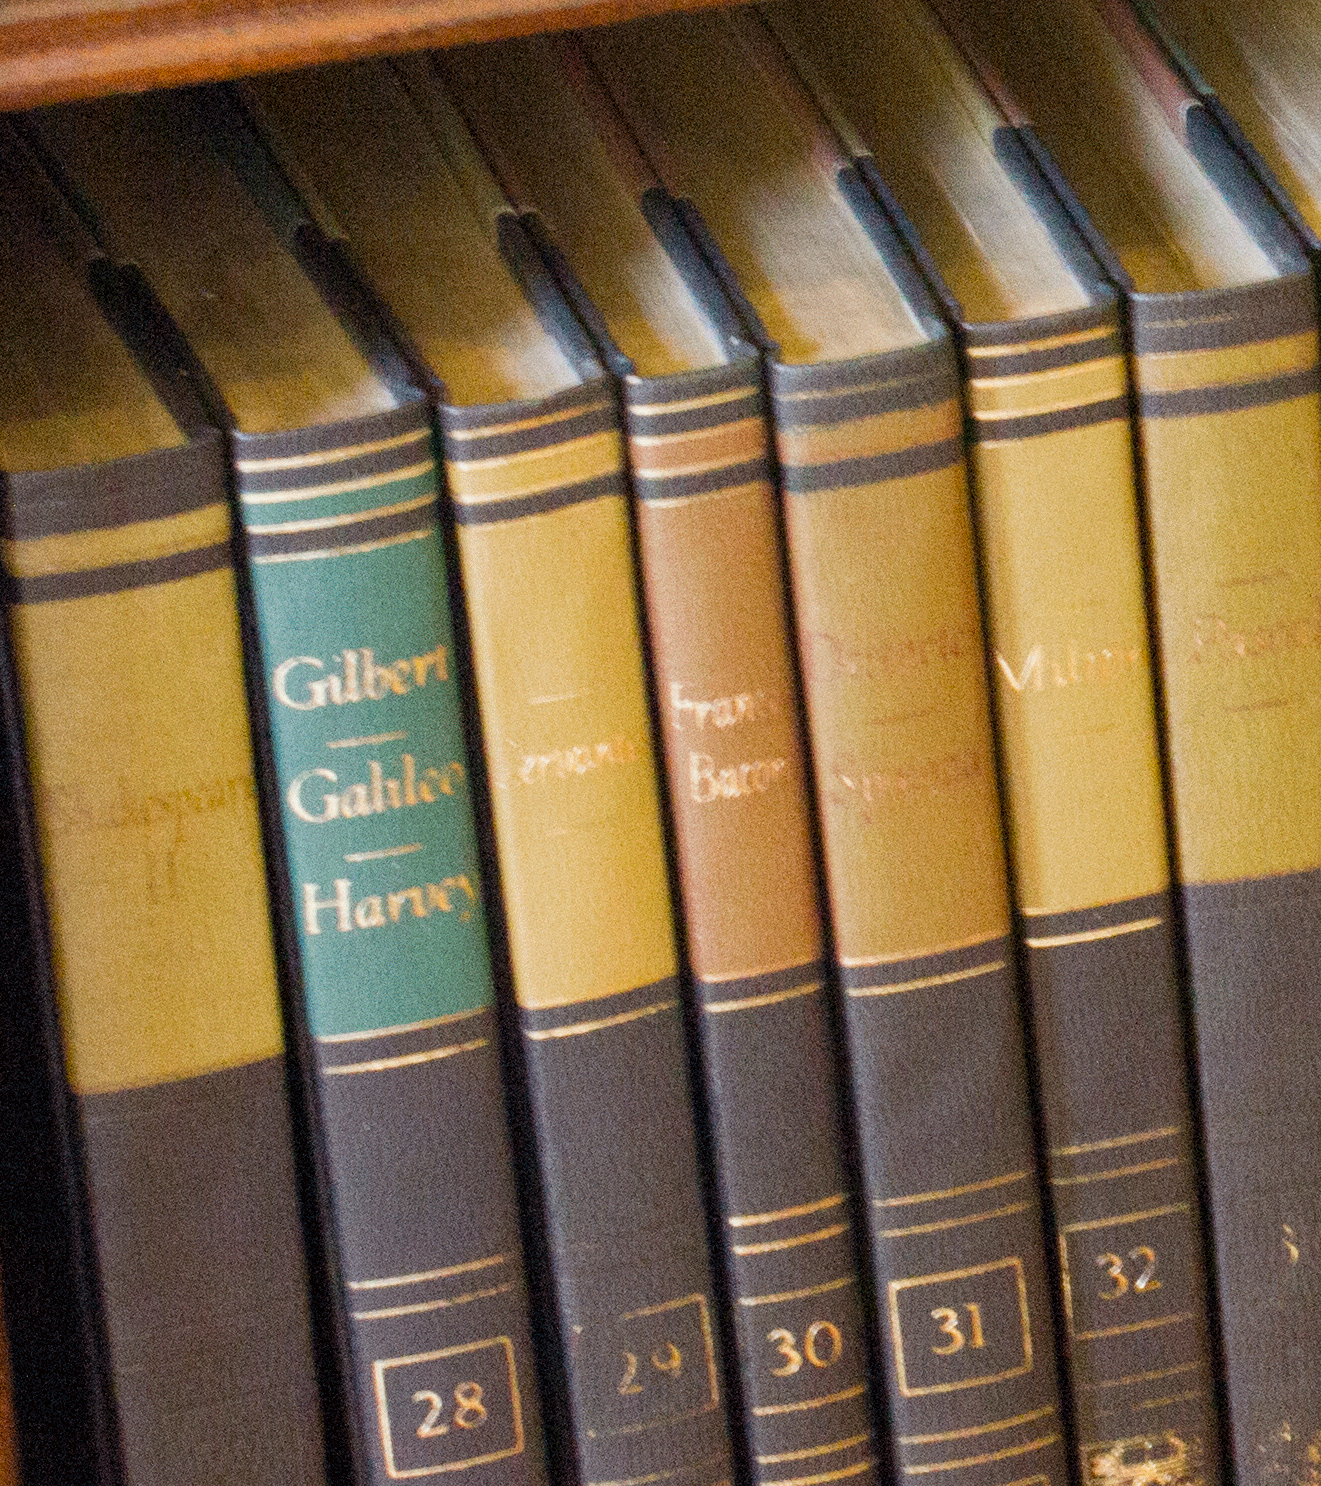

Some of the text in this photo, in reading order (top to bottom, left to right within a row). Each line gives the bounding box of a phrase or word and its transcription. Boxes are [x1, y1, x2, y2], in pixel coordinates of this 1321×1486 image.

[272, 645, 452, 712] Gilbert
[286, 753, 466, 826] Galileo
[302, 873, 478, 938] Harvey
[1094, 1244, 1163, 1300] 32
[765, 1318, 843, 1377] 30
[928, 1300, 987, 1357] 31
[615, 1340, 682, 1396] 29
[411, 1380, 489, 1440] 28
